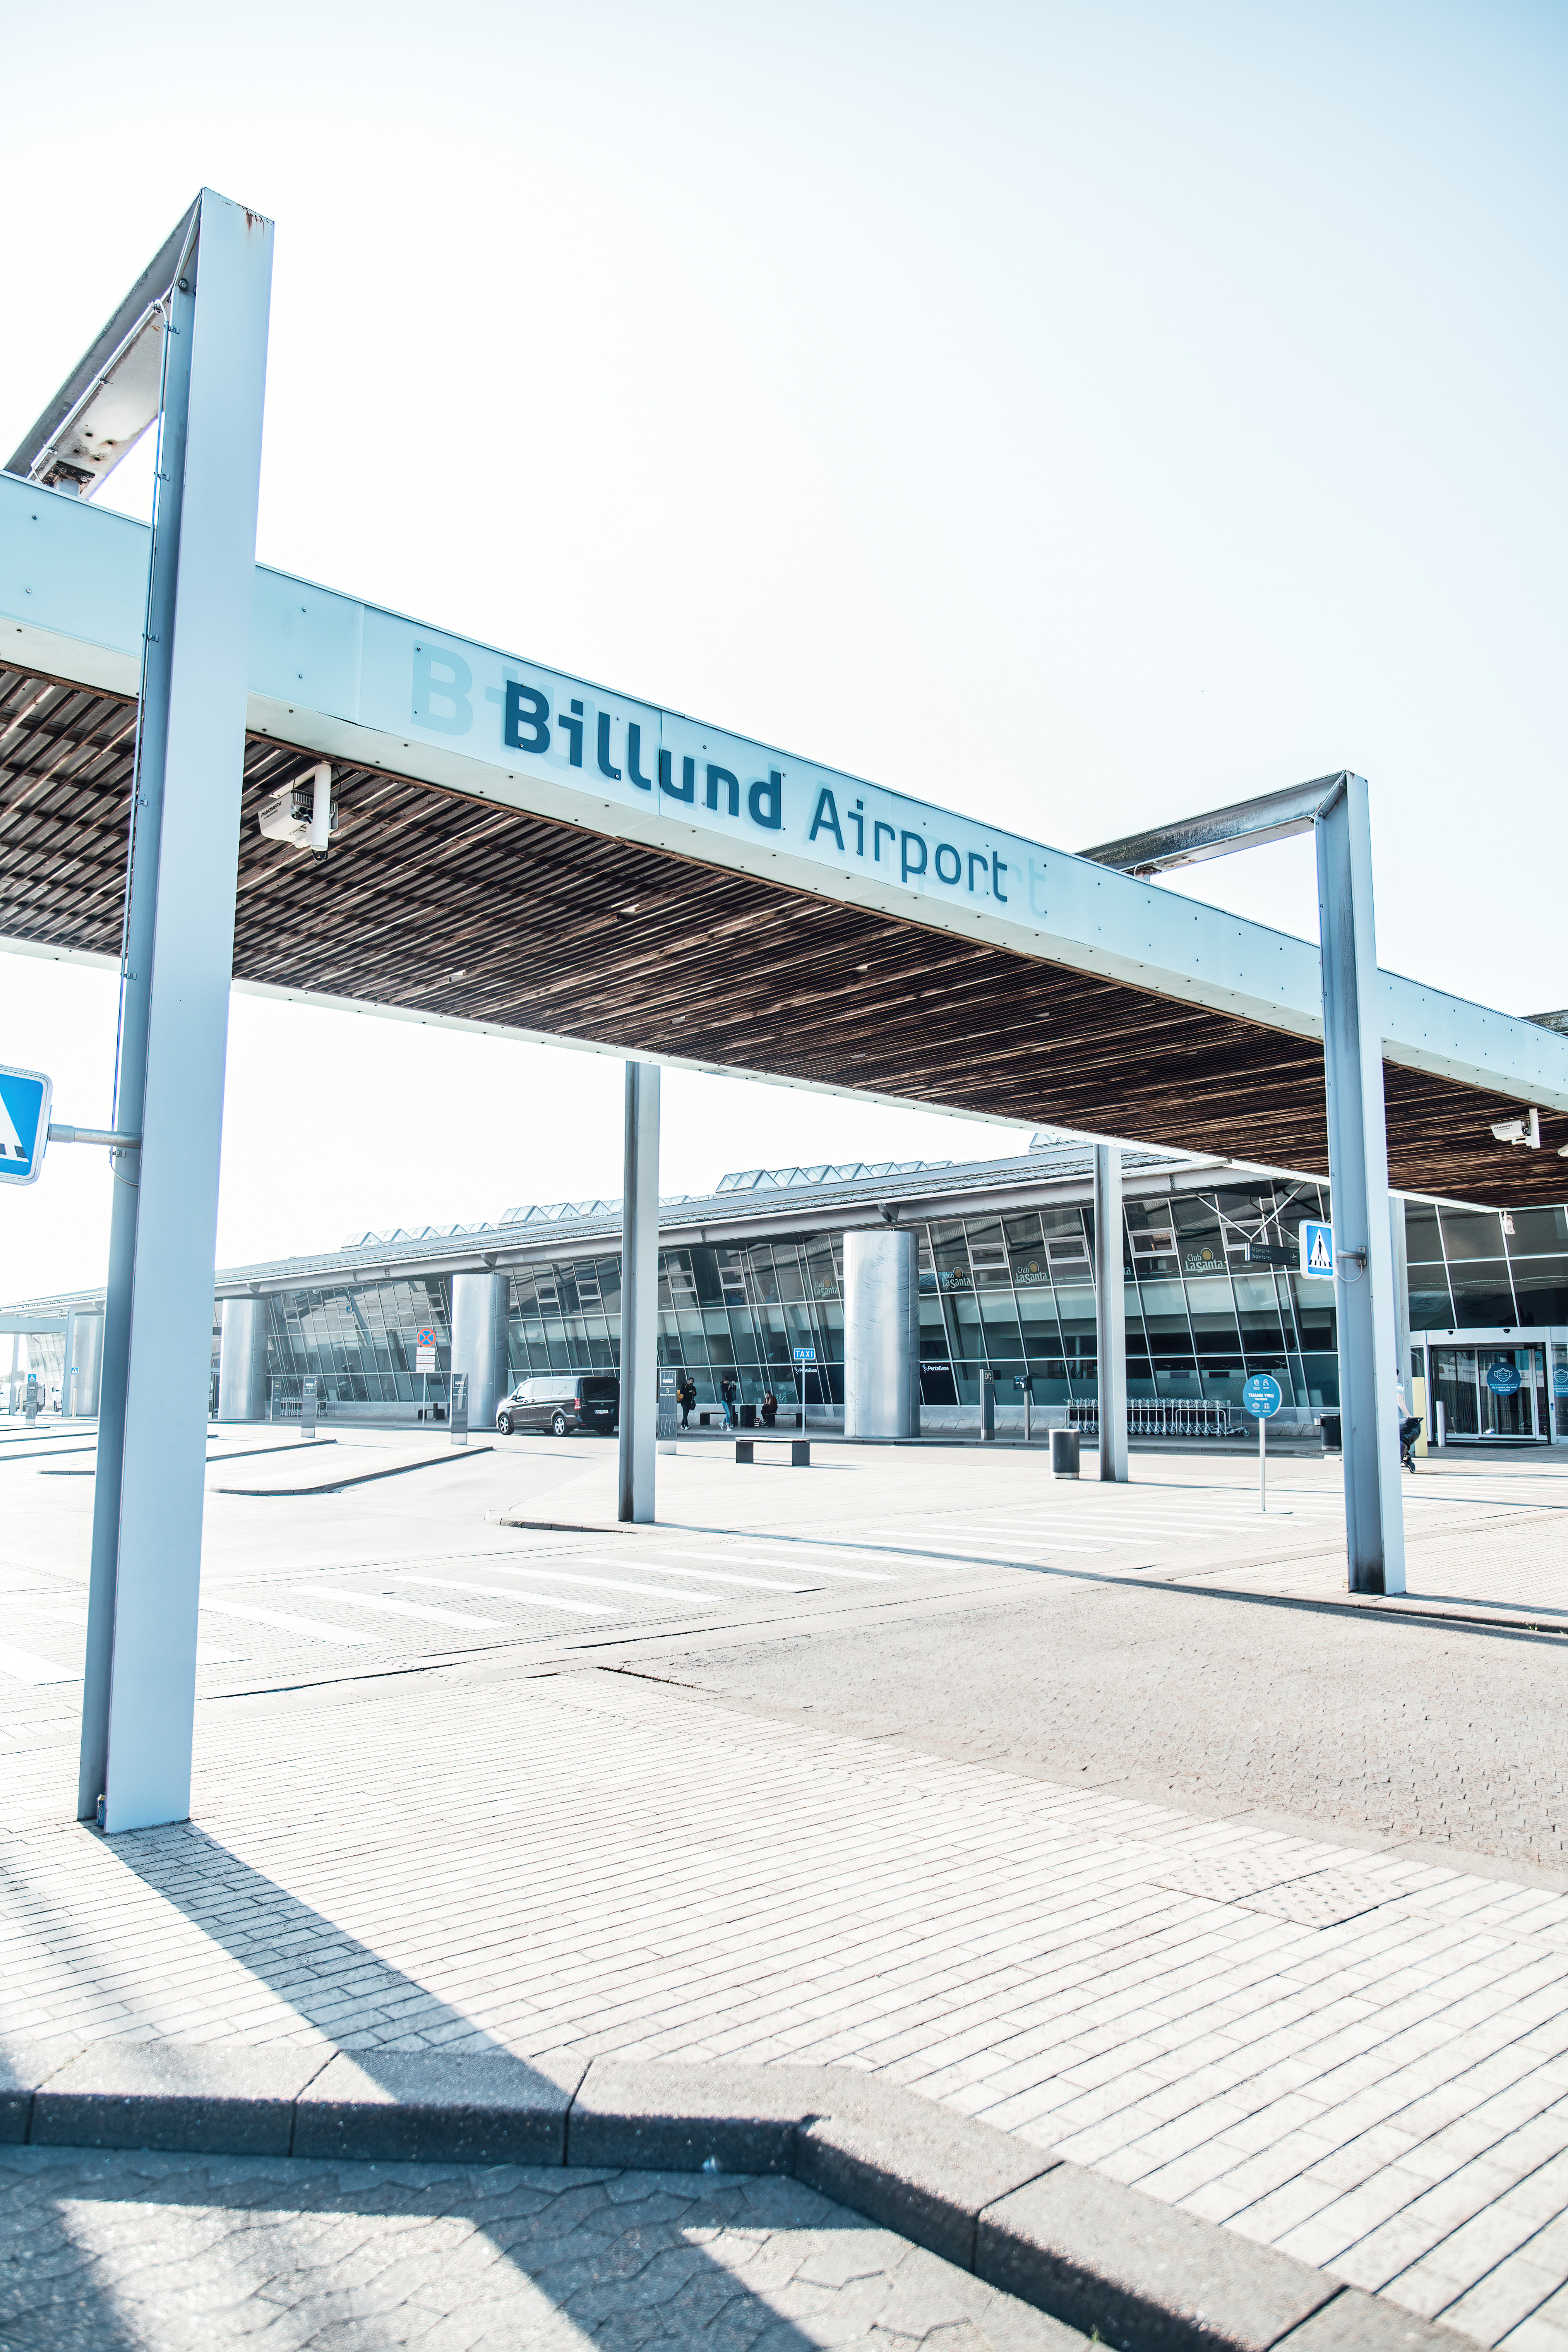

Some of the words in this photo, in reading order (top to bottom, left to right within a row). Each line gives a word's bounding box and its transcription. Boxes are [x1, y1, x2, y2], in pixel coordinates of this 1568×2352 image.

[261, 801, 282, 818] PANOMERA
[505, 680, 781, 829] Billund
[809, 788, 1007, 902] Airport
